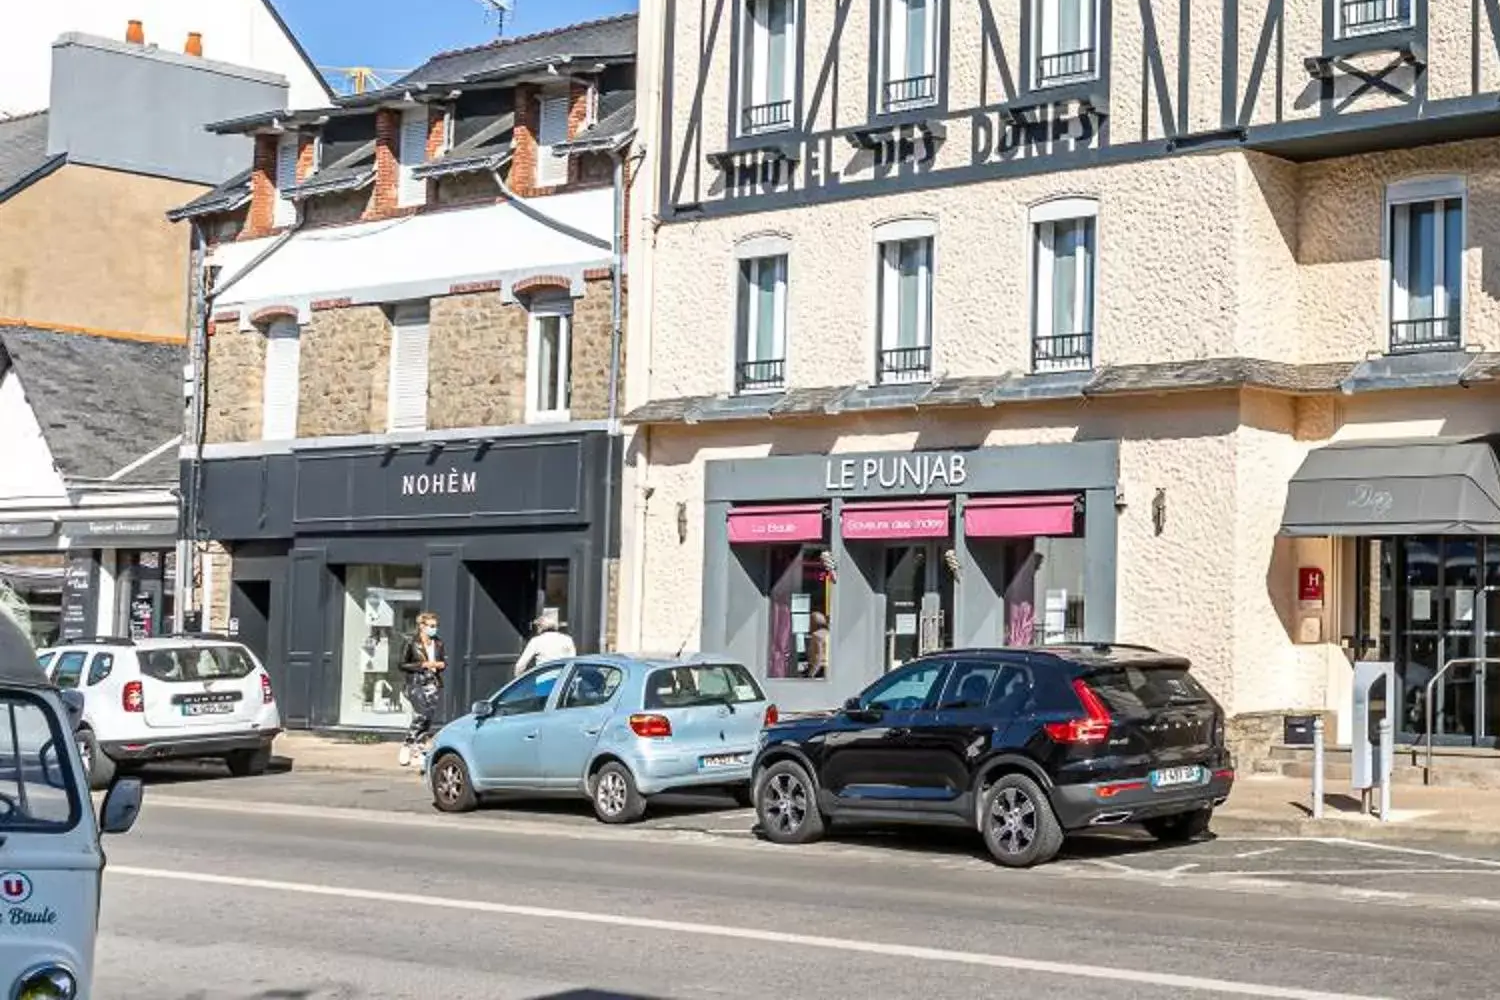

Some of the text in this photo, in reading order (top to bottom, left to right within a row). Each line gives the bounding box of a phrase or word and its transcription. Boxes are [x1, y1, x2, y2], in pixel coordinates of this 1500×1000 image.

[402, 467, 477, 494] NOHÈM
[825, 454, 967, 494] LE PUNJAB
[1309, 573, 1319, 586] H
[3, 879, 24, 896] U
[8, 906, 57, 926] Baule
